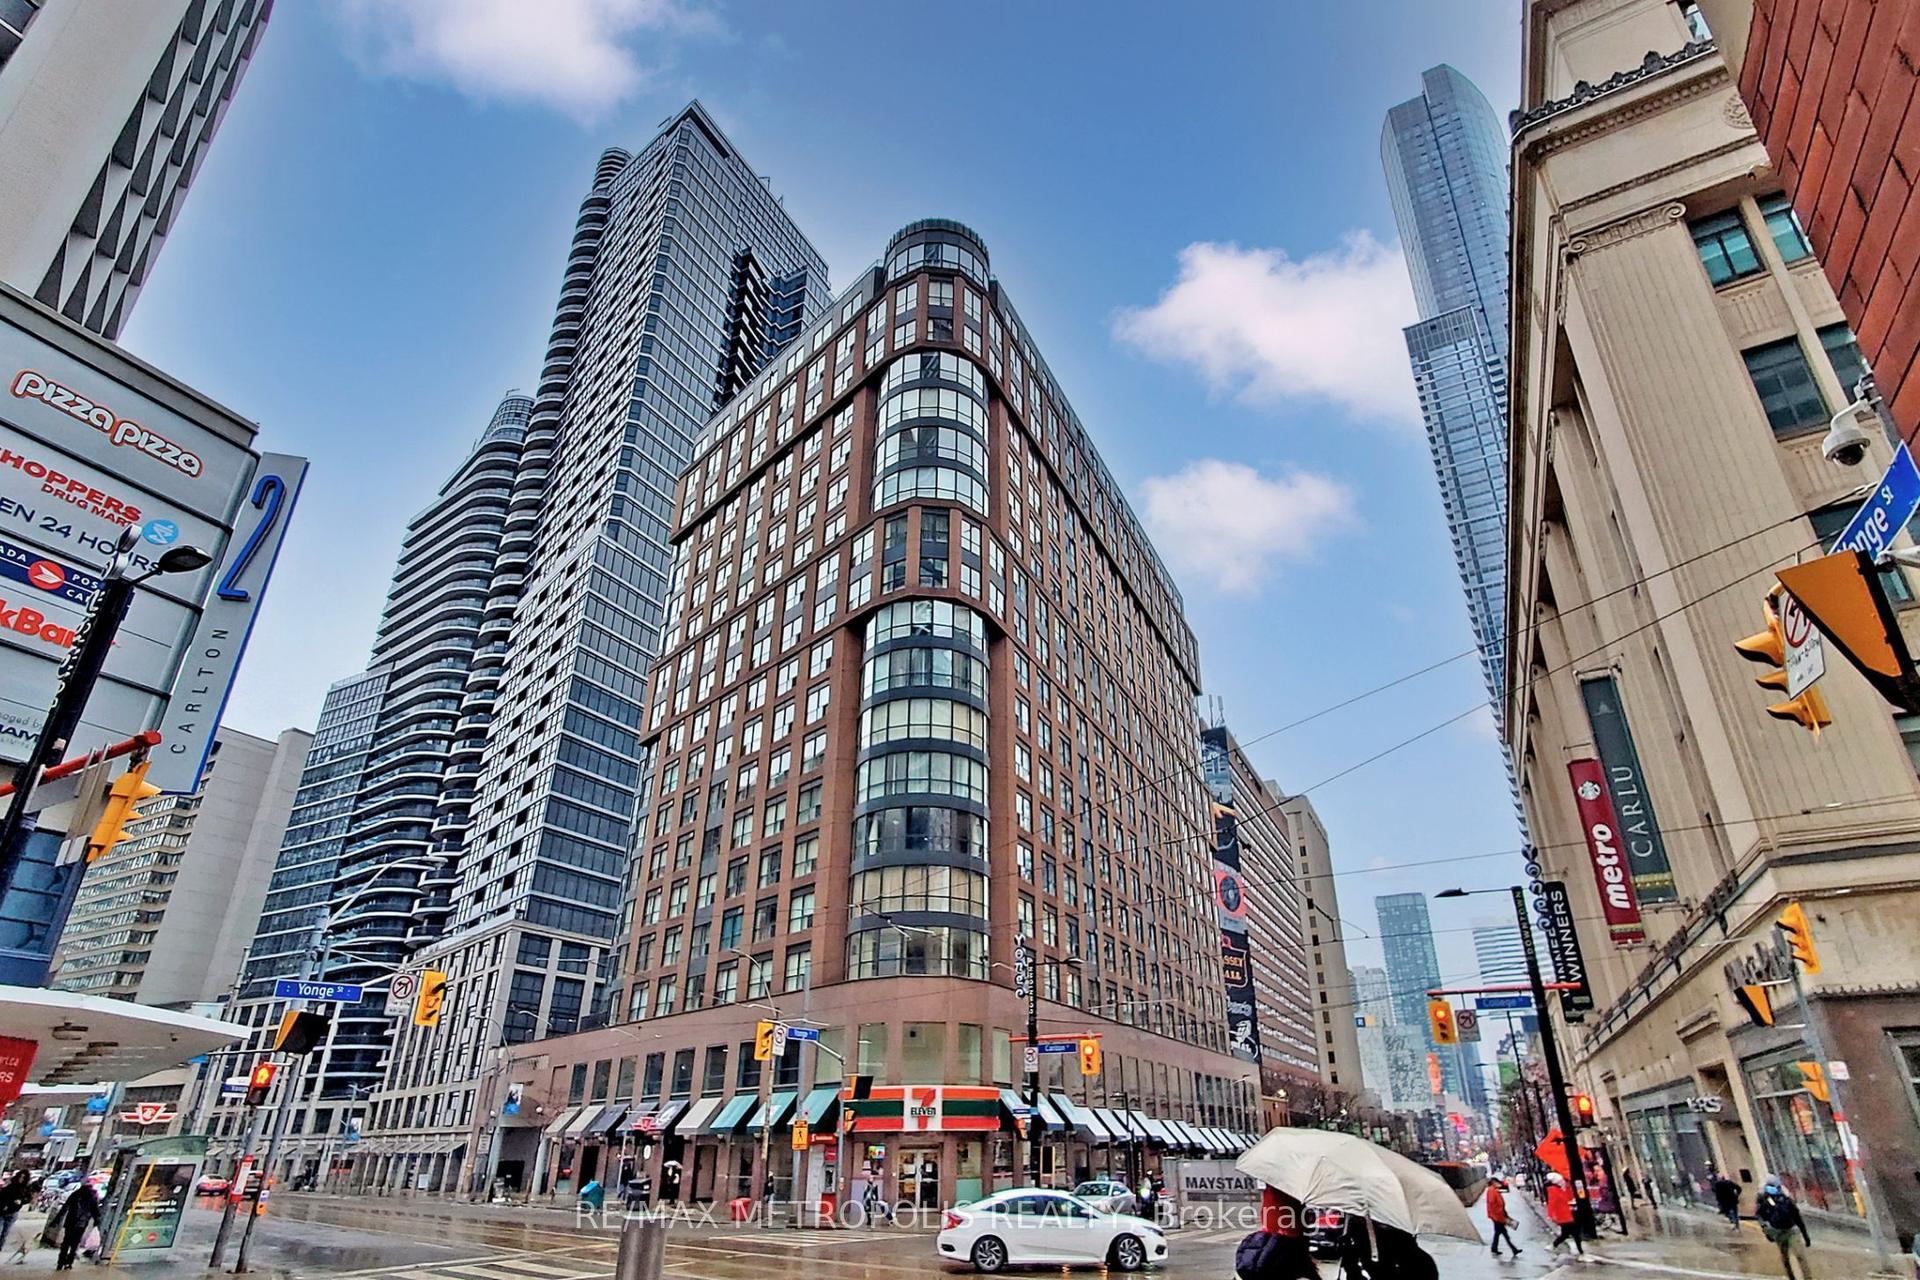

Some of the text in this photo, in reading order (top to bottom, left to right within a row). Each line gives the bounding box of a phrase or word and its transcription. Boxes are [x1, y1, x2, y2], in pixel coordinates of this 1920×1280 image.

[0, 447, 142, 522] HOPPERS
[41, 483, 88, 510] DRUG
[1836, 485, 1894, 552] nge St
[39, 517, 72, 539] 24
[216, 475, 286, 602] 2
[72, 573, 98, 589] POS
[170, 629, 229, 754] CARLTON
[1611, 766, 1654, 858] CARLU
[1592, 823, 1631, 909] metro
[1551, 889, 1582, 982] WINNERS
[298, 983, 334, 999] Yonge
[1185, 1176, 1256, 1190] MAYSTAR
